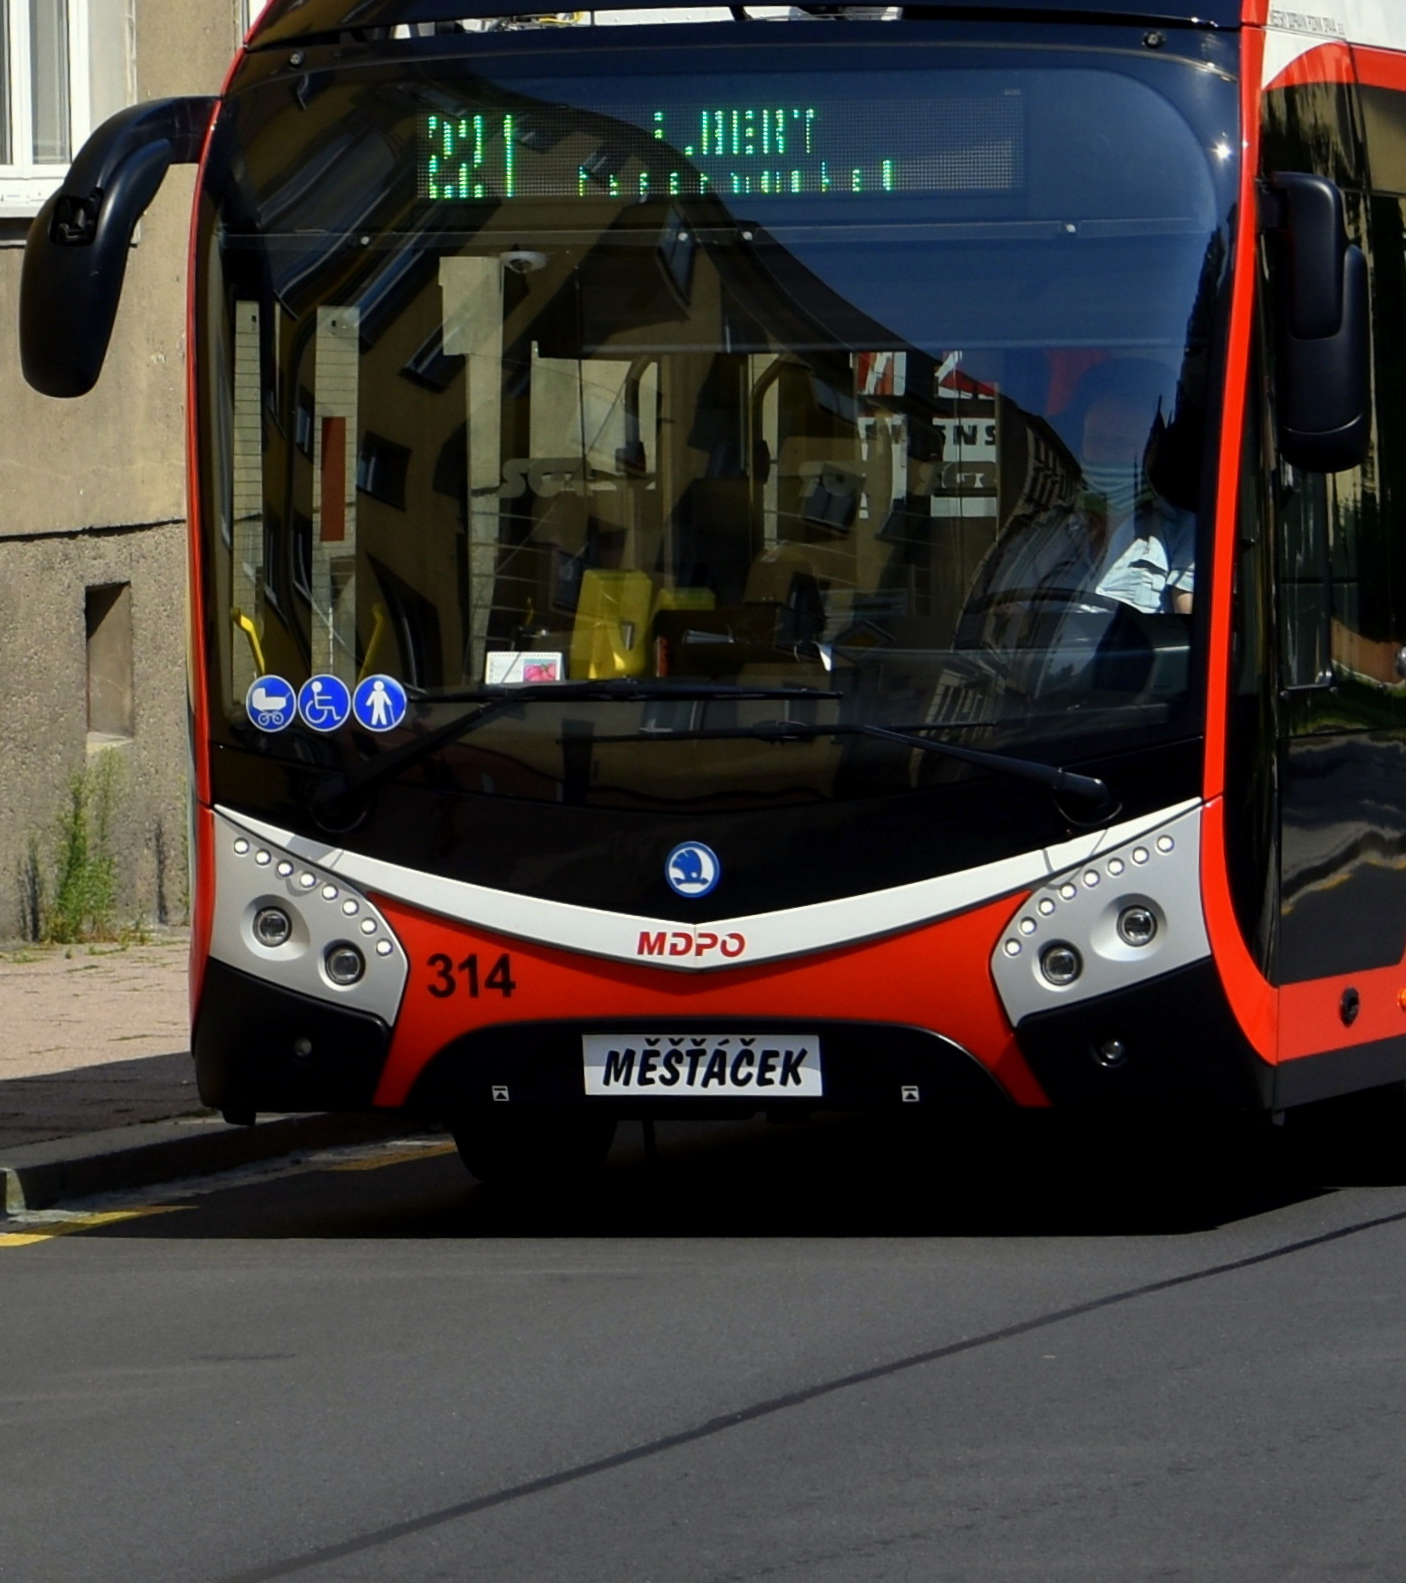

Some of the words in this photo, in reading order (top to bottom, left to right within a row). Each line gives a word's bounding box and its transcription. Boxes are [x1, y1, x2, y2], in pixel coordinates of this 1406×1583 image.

[637, 931, 746, 958] MDPO
[426, 953, 517, 999] 314
[602, 1037, 808, 1089] MĚŠŤÁČEK
